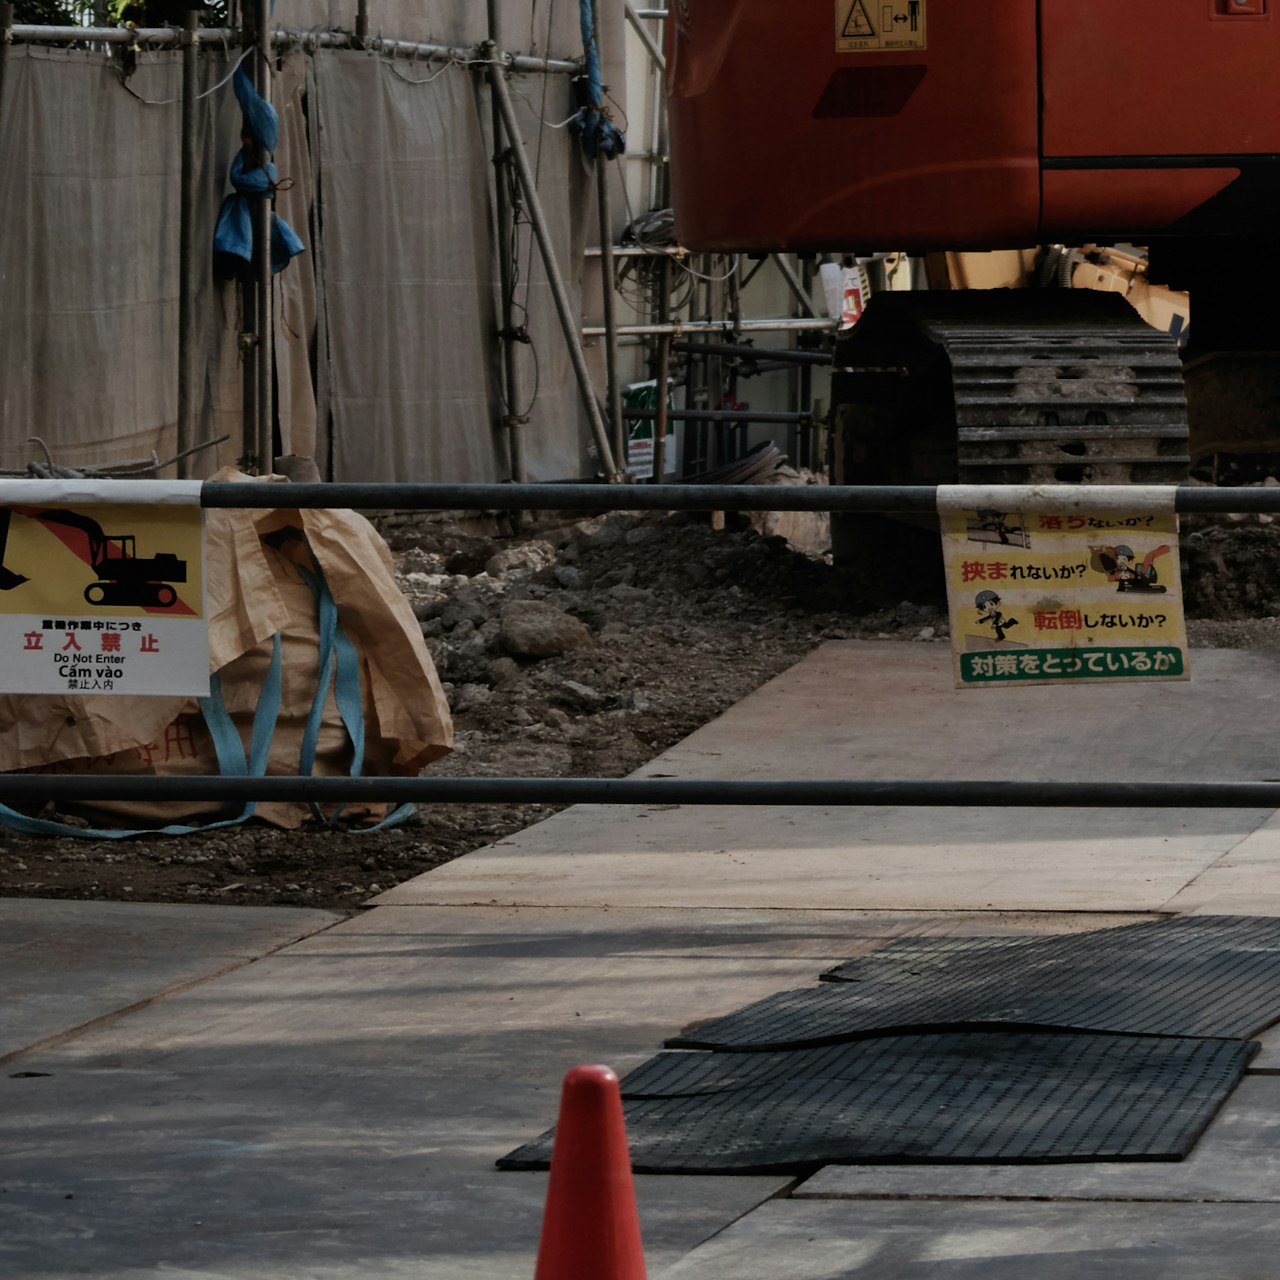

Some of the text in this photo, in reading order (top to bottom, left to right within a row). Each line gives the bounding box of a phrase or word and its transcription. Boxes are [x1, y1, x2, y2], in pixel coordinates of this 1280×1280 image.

[961, 561, 1087, 583] 挟まれないか?
[41, 619, 142, 631] 重機作業中につき
[1033, 609, 1167, 631] 転倒しないか?
[24, 632, 159, 653] 立入禁止
[54, 653, 126, 664] Do Not Enter
[970, 650, 1176, 677] 対策をとっているか
[58, 663, 123, 679] Cấm vào
[67, 678, 114, 691] 禁止入内
